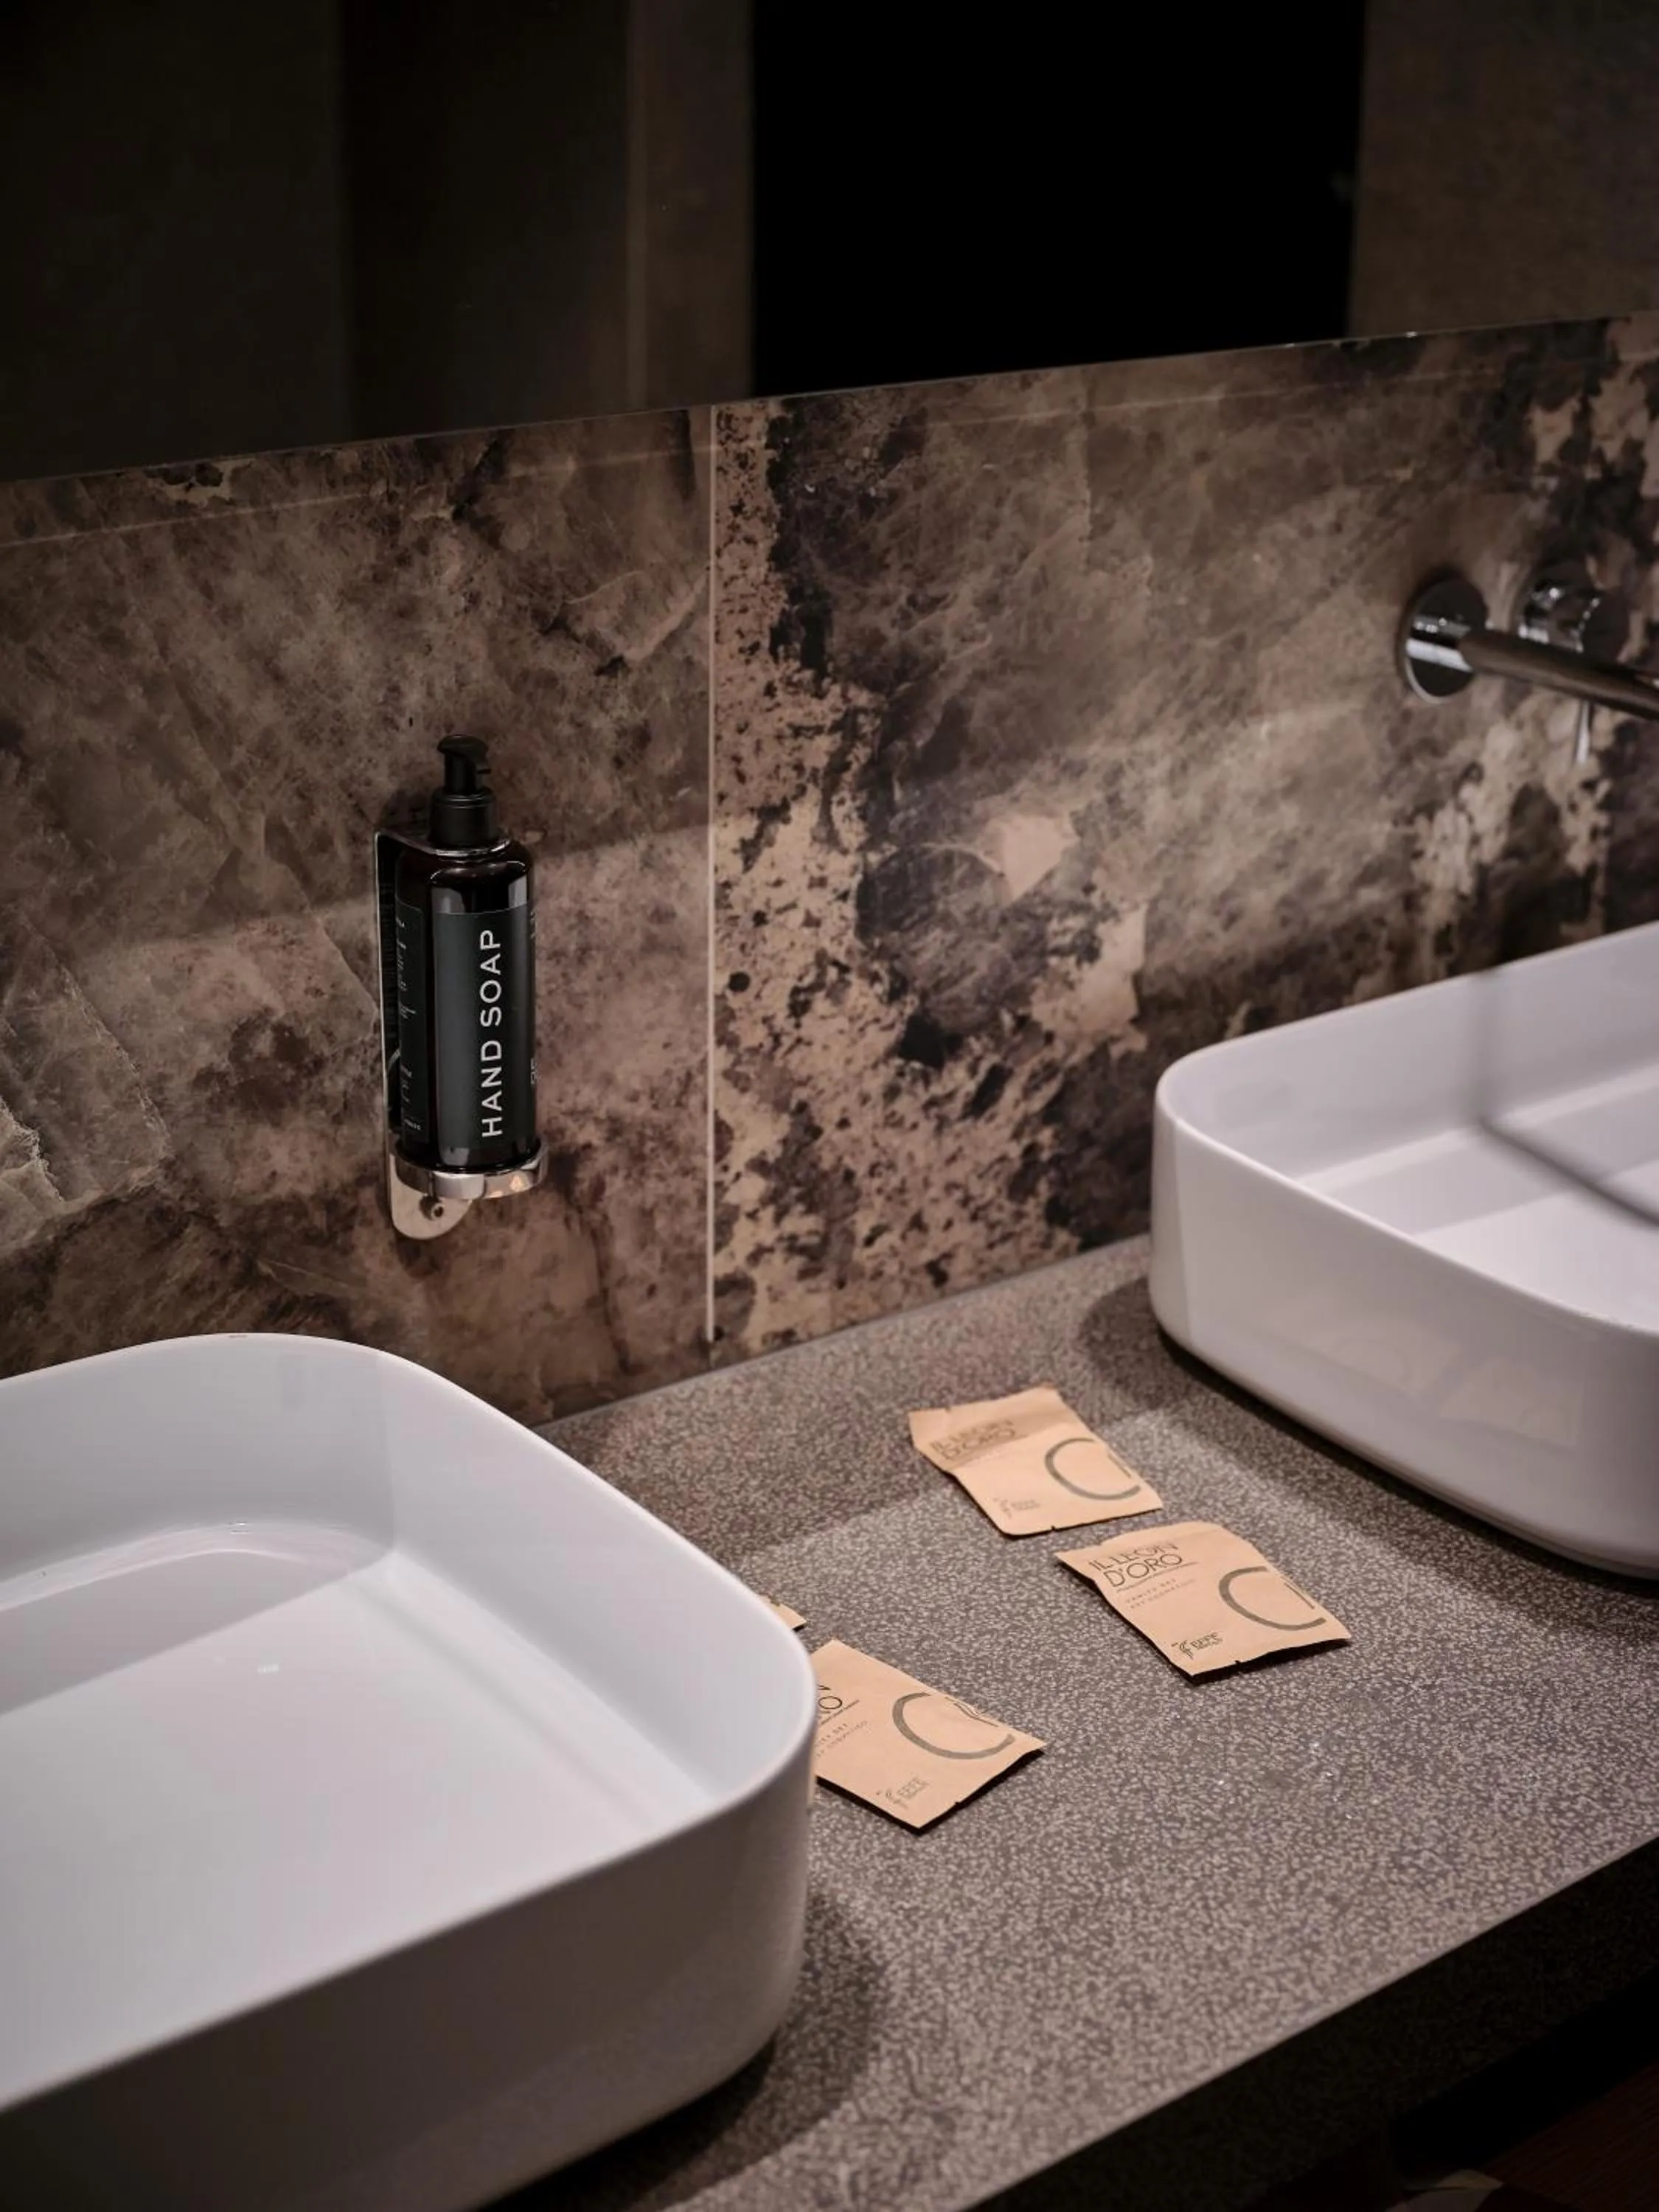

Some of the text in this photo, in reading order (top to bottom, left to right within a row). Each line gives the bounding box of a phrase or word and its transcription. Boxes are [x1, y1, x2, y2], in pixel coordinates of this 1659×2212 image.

[479, 930, 503, 1138] HAND SOAP
[1103, 1554, 1183, 1587] D'ORO
